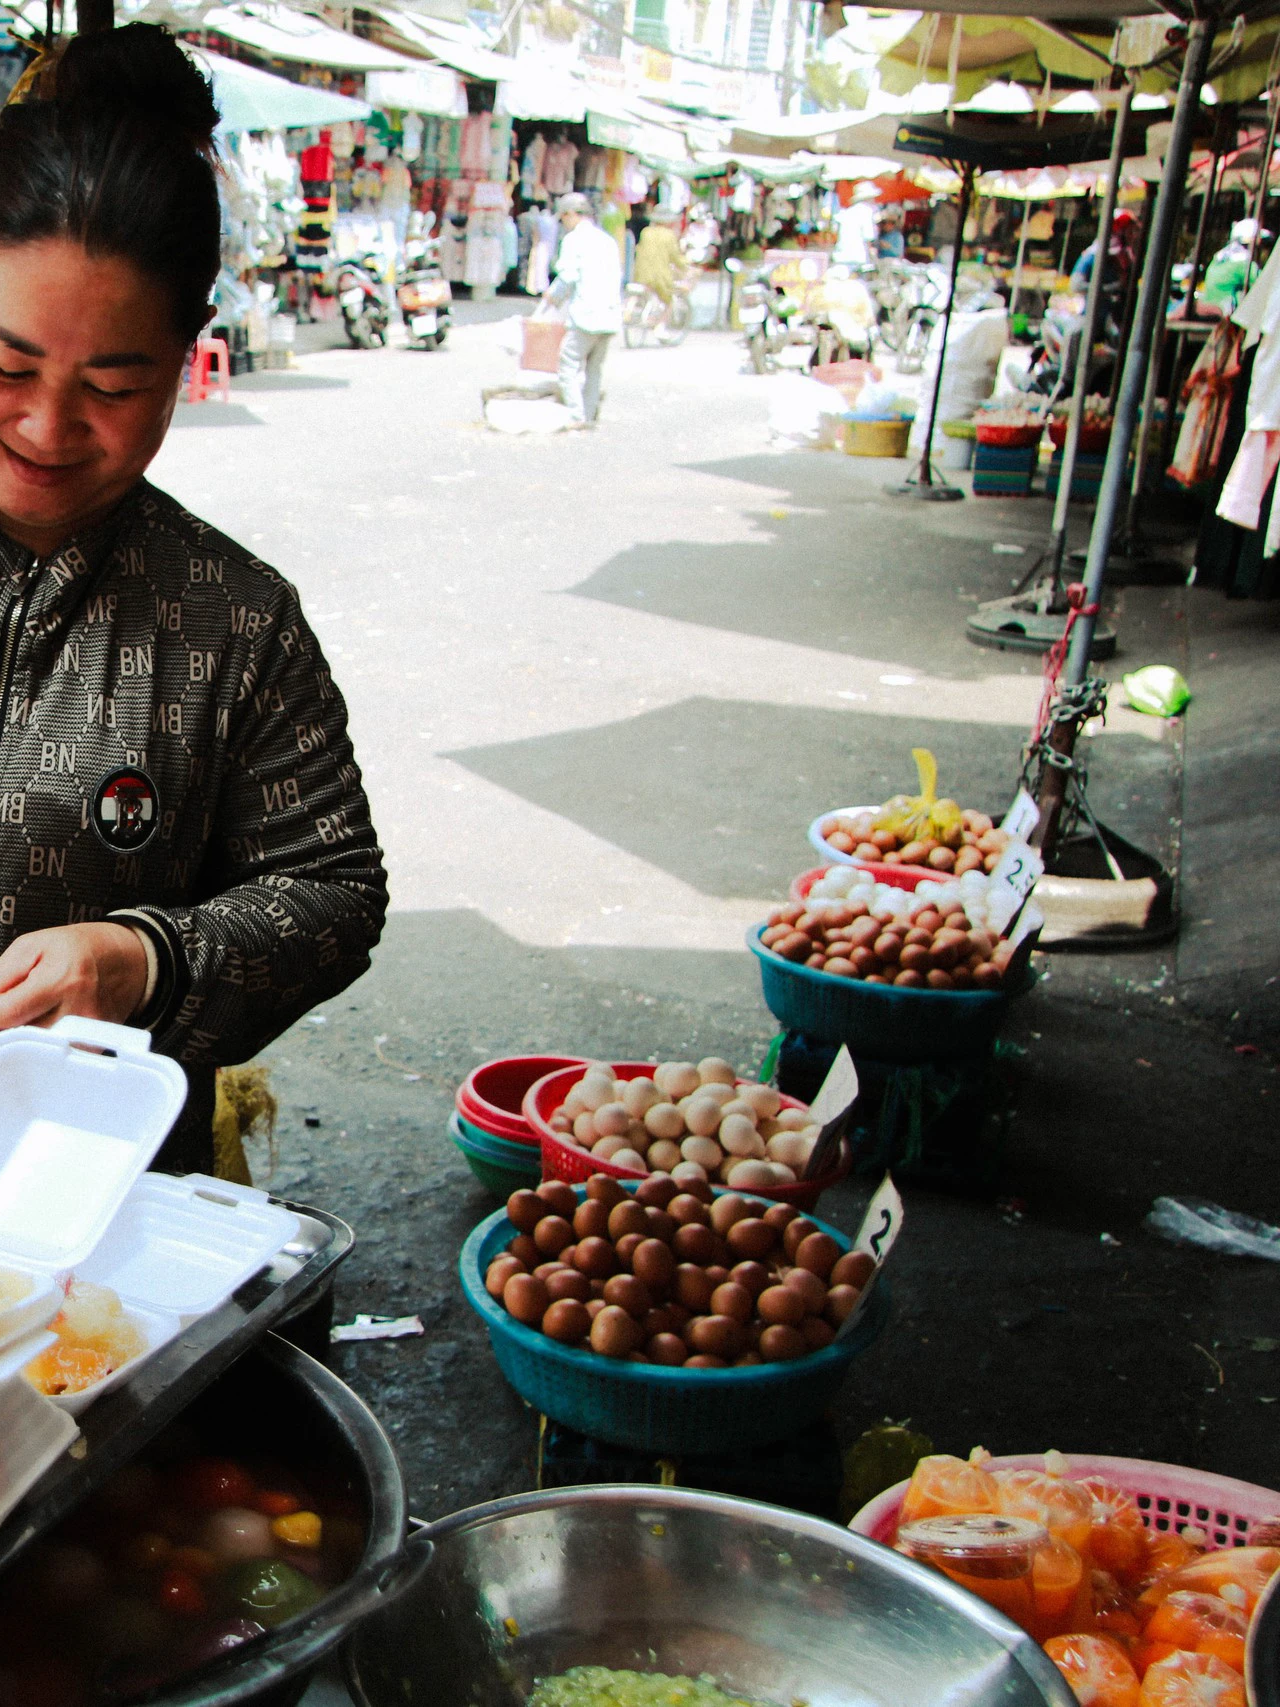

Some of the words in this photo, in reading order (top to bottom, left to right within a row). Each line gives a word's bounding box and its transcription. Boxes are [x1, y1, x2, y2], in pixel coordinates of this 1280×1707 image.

[189, 558, 223, 584] BN
[120, 643, 154, 676] BN
[40, 741, 77, 774] BN
[315, 811, 354, 845] BN
[29, 846, 66, 878] BN
